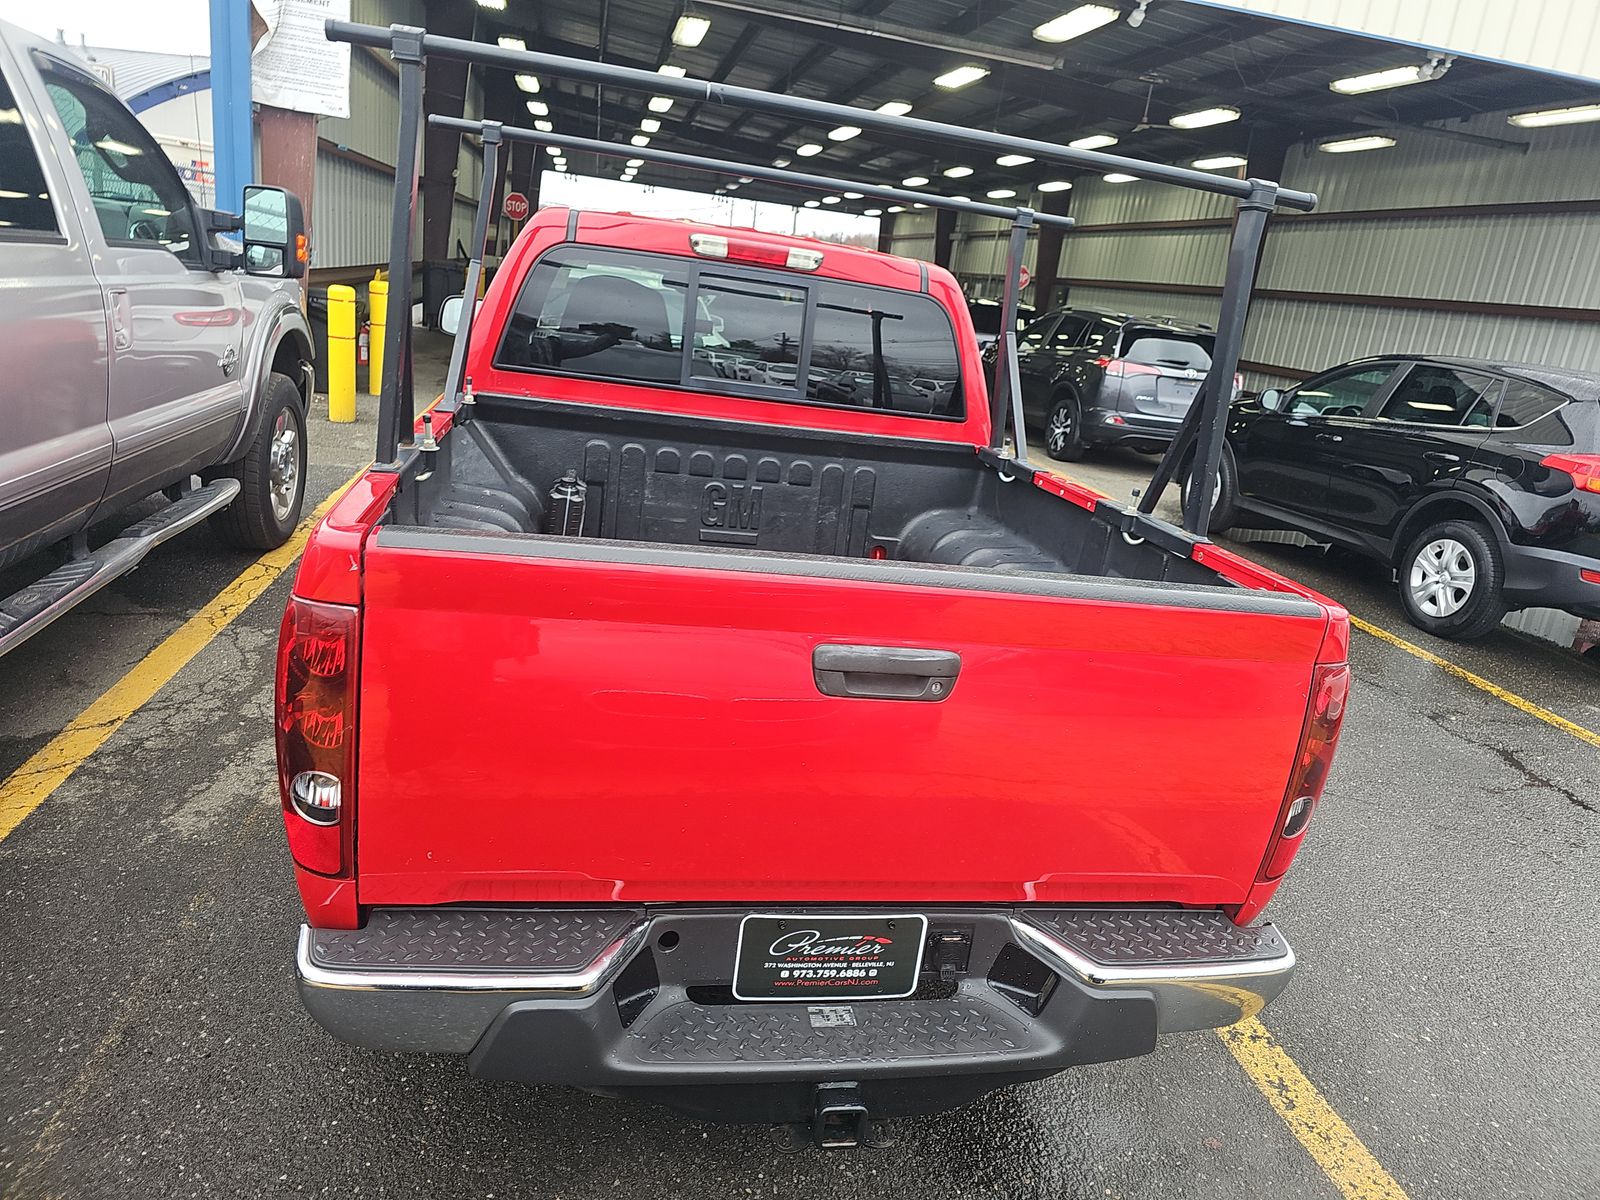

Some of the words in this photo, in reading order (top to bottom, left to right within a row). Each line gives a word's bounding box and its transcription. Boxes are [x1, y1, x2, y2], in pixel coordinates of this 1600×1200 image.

[507, 200, 527, 212] STOP
[701, 481, 763, 530] GM
[769, 930, 885, 956] Premier
[792, 969, 866, 978] 973.759.6886
[774, 979, 879, 987] www.PremierCarsNJ.com
